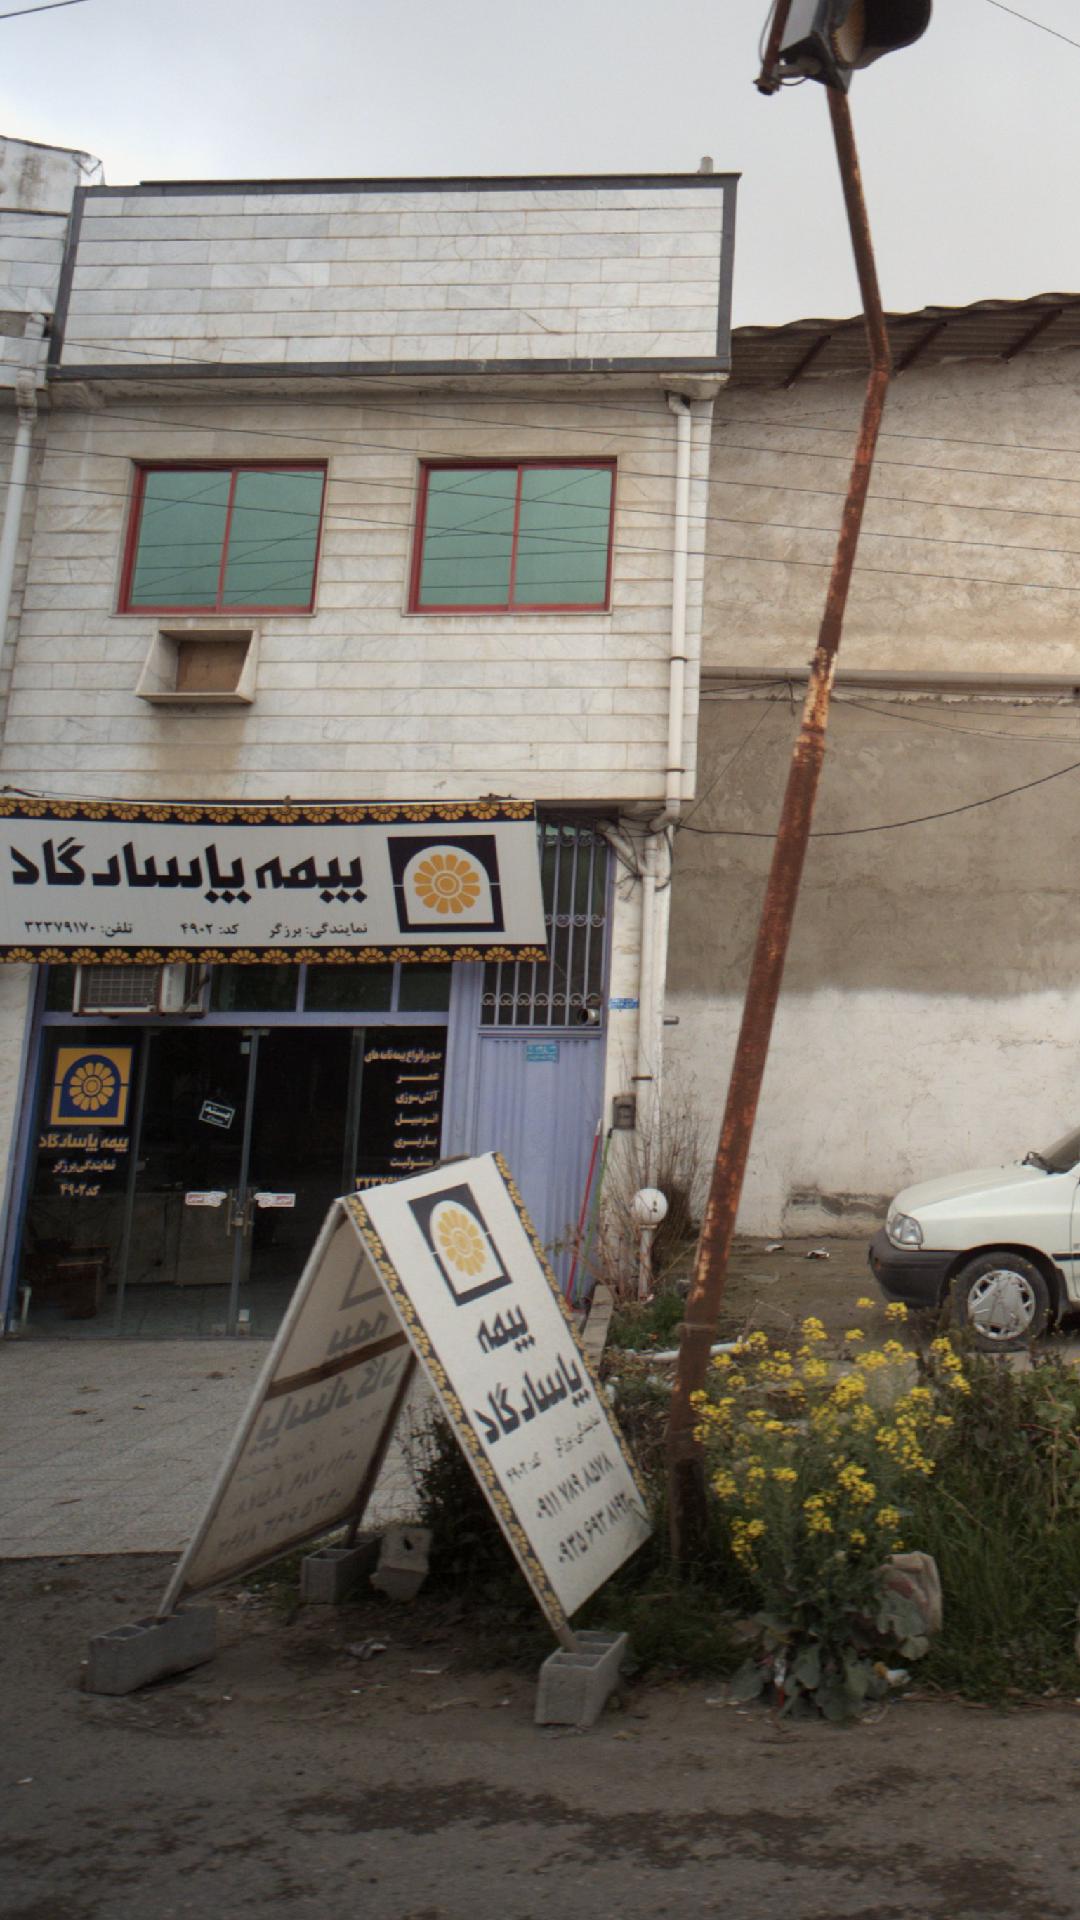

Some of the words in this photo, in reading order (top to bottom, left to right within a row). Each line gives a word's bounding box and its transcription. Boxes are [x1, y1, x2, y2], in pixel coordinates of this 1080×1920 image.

[10, 837, 252, 904] پاسارگاد
[255, 855, 368, 904] بیمه
[25, 921, 96, 934] ۳۲۳۷۹۱۷۰
[100, 921, 133, 937] تلفن:
[180, 922, 213, 935] ۴۹۰۲
[218, 922, 240, 935] کد:
[269, 922, 302, 939] برزگر
[305, 921, 368, 939] نمایندگی:
[38, 1133, 99, 1152] پاسارگاد
[100, 1136, 129, 1152] بیمه
[475, 1304, 536, 1353] بیمه
[473, 1353, 591, 1445] پاسارگاد
